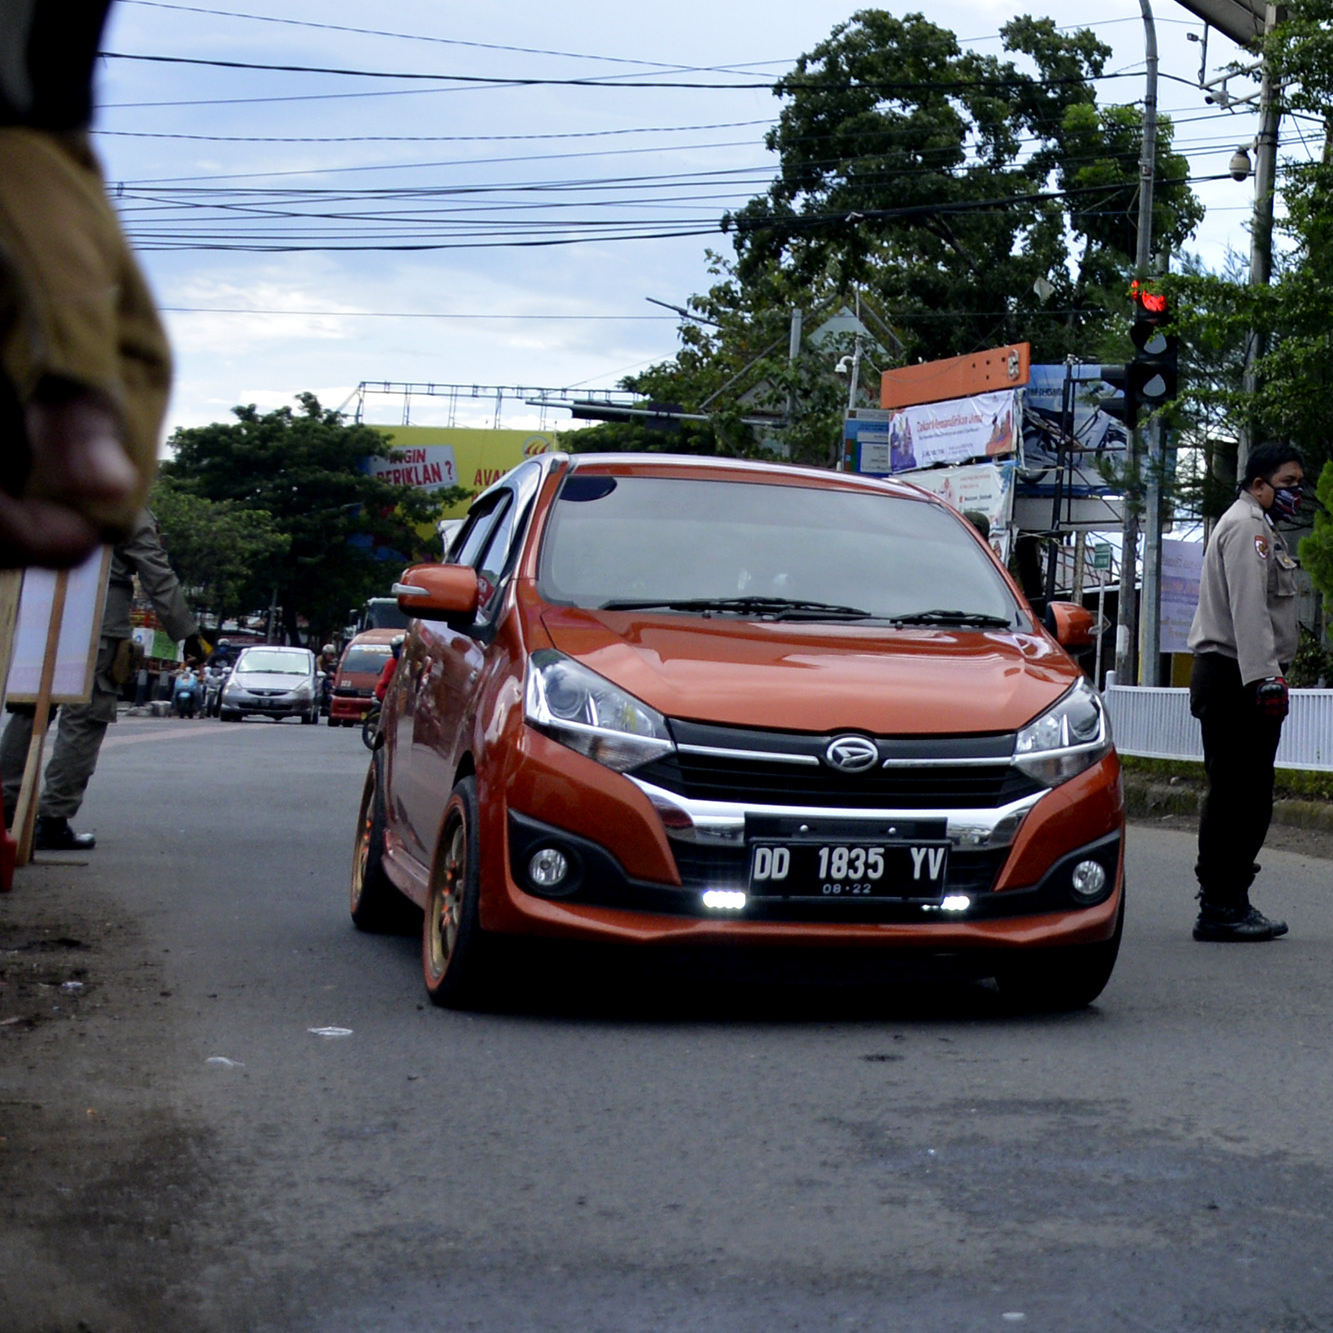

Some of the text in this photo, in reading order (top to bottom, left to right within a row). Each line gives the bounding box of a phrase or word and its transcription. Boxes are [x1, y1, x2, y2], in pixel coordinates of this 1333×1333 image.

[753, 847, 945, 880] DD 1835 YV
